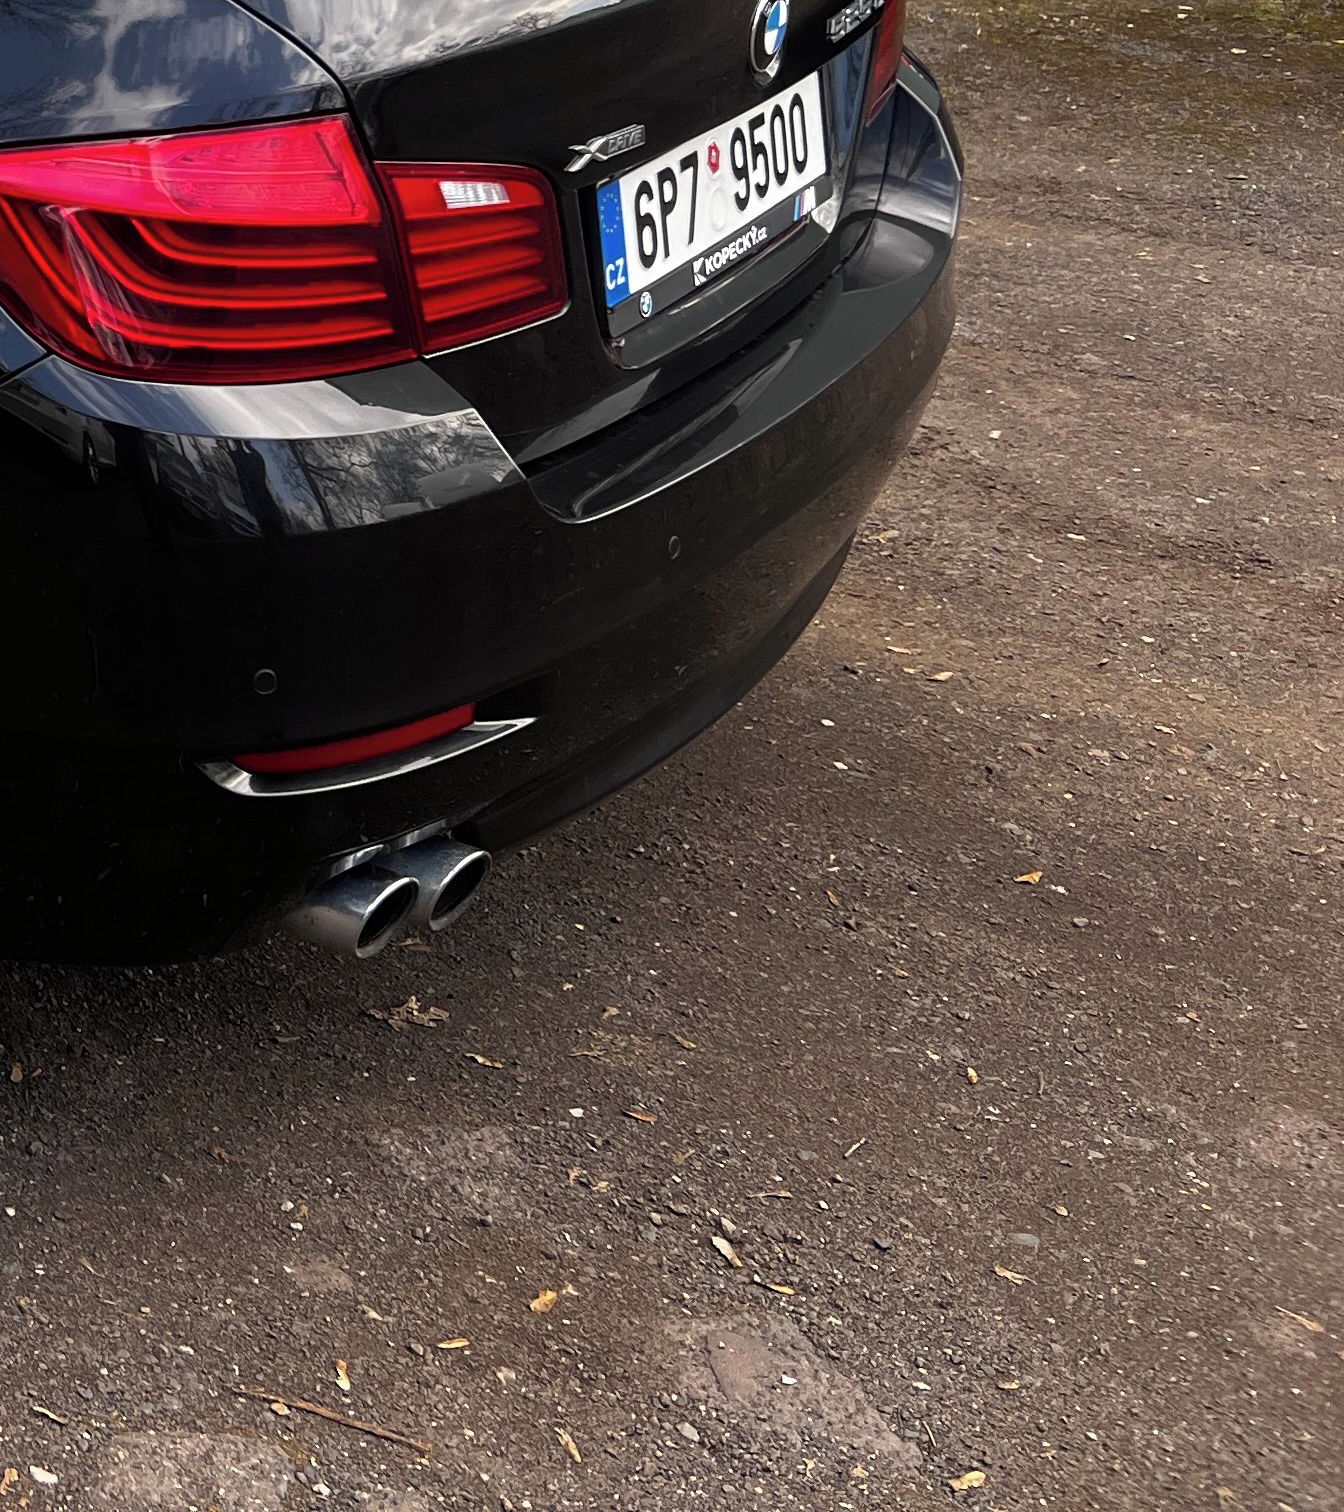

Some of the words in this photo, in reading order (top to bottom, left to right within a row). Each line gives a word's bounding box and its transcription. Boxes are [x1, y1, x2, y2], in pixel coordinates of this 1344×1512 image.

[634, 151, 700, 270] 6P7
[730, 92, 809, 212] 9500
[605, 257, 626, 291] CZ
[706, 225, 768, 276] KOPECKÝ.cz
